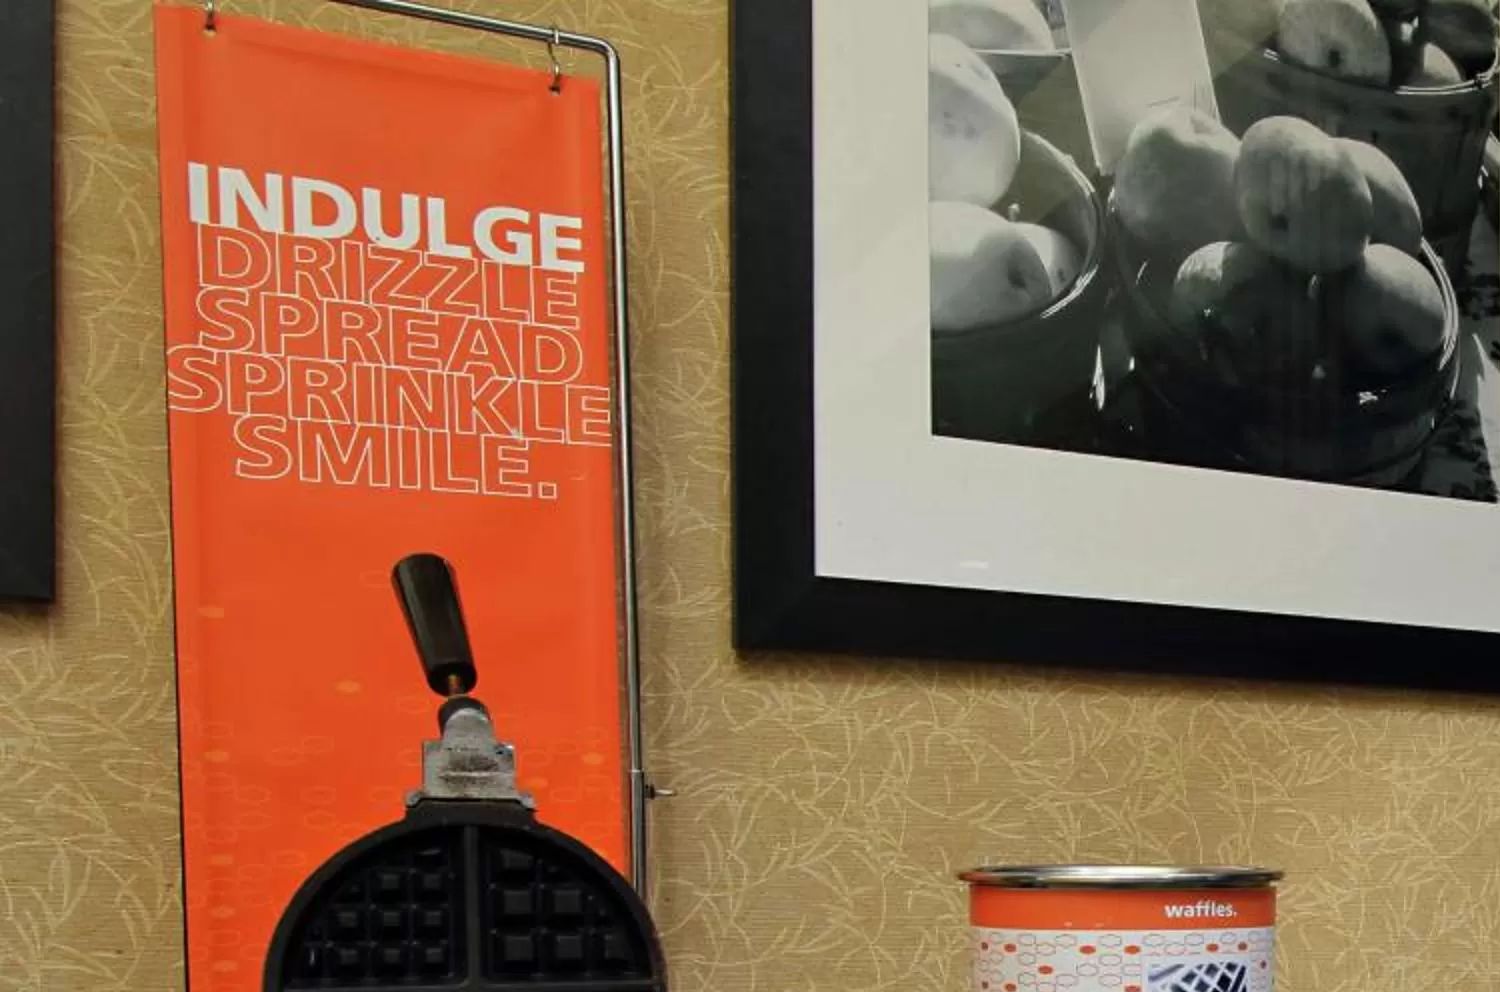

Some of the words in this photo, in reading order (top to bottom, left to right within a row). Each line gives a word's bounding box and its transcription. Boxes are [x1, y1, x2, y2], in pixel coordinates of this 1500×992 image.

[188, 161, 585, 273] INDULGE
[197, 222, 581, 330] DRIZZLE
[196, 285, 584, 385] SPREAD
[166, 344, 613, 447] SPRINKLE
[234, 414, 558, 500] SMILE.
[1163, 900, 1238, 919] waffles.
